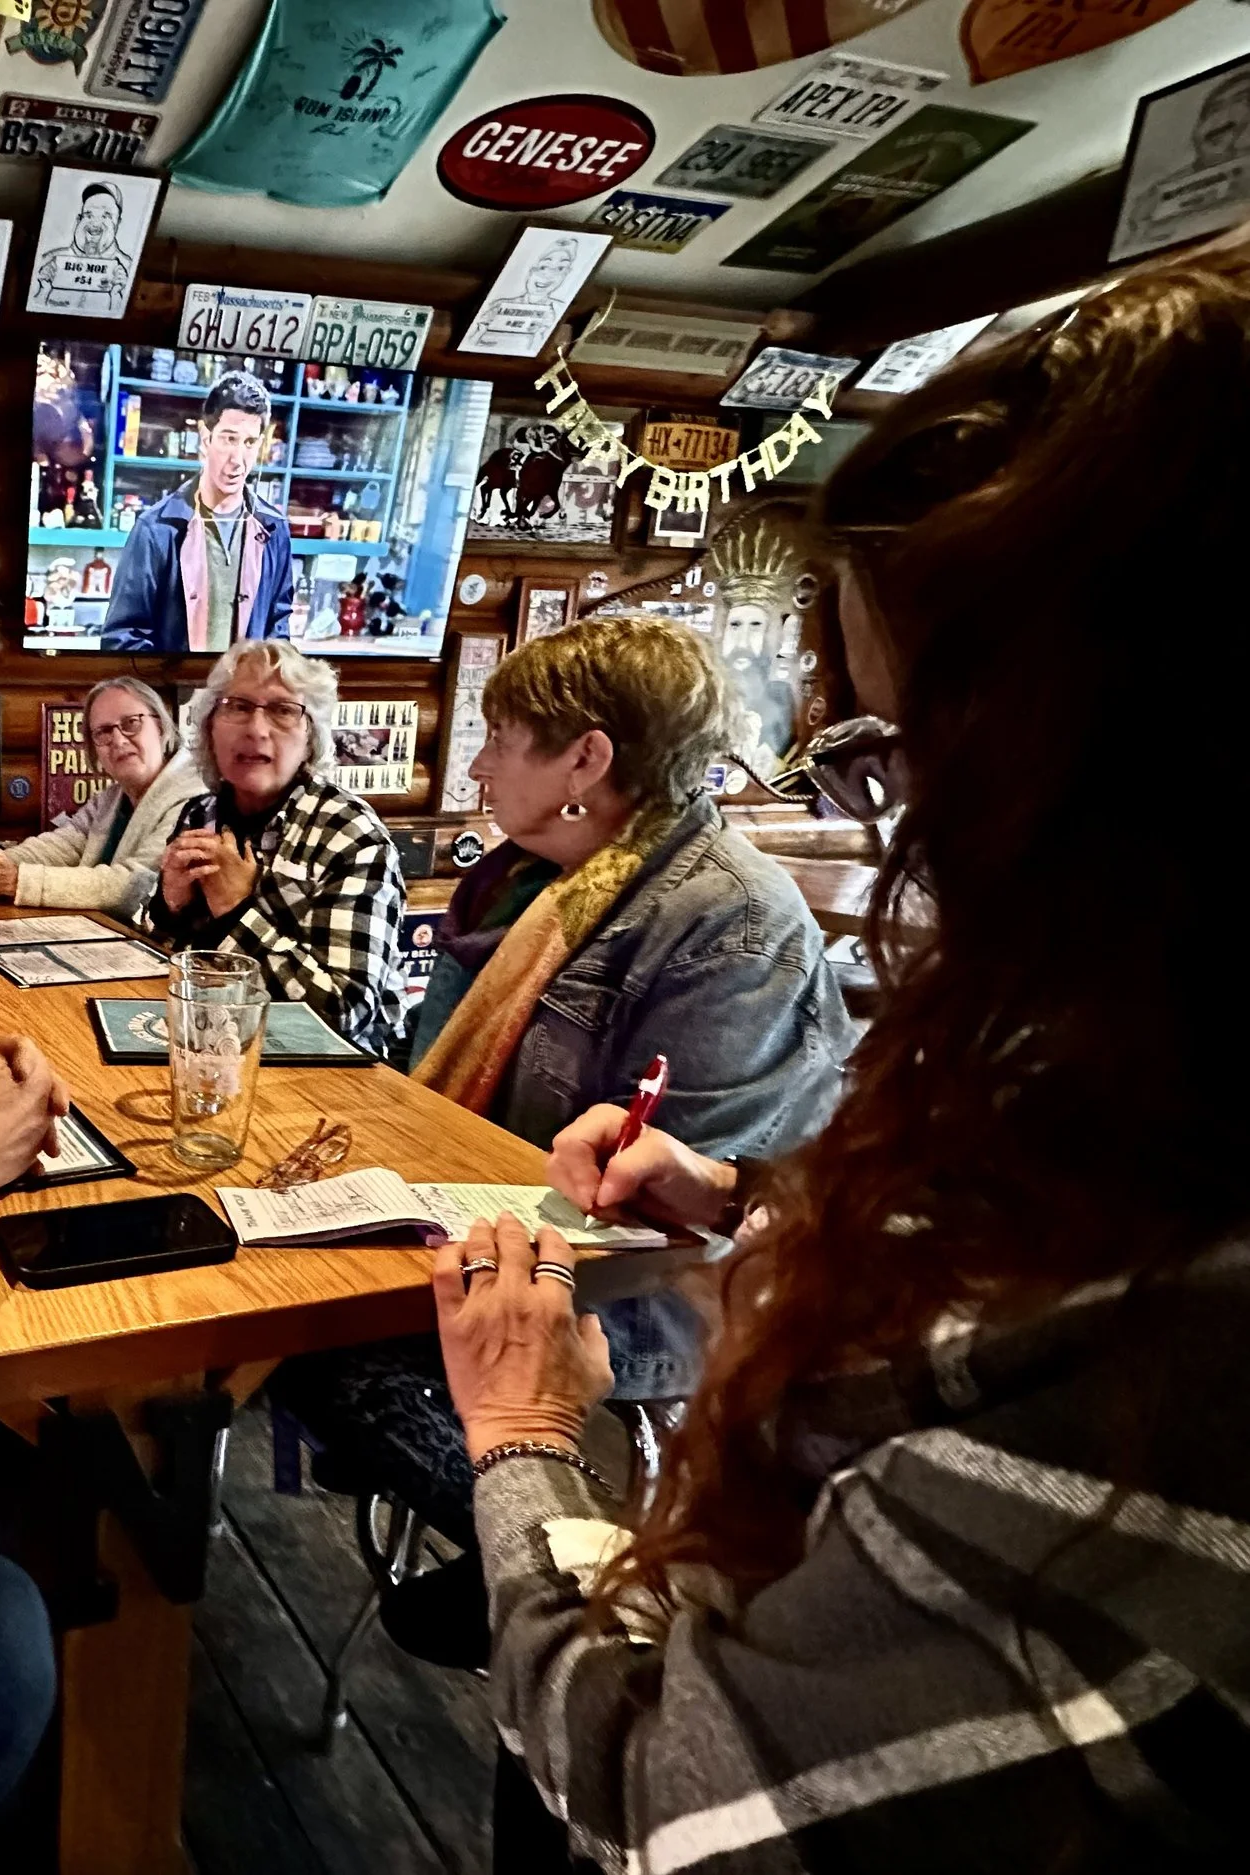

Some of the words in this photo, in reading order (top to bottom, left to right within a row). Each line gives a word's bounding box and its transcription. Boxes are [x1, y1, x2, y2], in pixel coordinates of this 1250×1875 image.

[55, 106, 109, 124] UTAH
[775, 81, 864, 122] APEX
[842, 92, 910, 128] IPA
[462, 121, 643, 177] GENESEE
[64, 261, 83, 272] BIG
[85, 264, 108, 274] MOE
[193, 290, 210, 302] FEB
[187, 308, 241, 349] 6HJ
[245, 312, 299, 353] 612
[329, 309, 348, 321] NEW
[644, 370, 833, 520] BIRTHDAY
